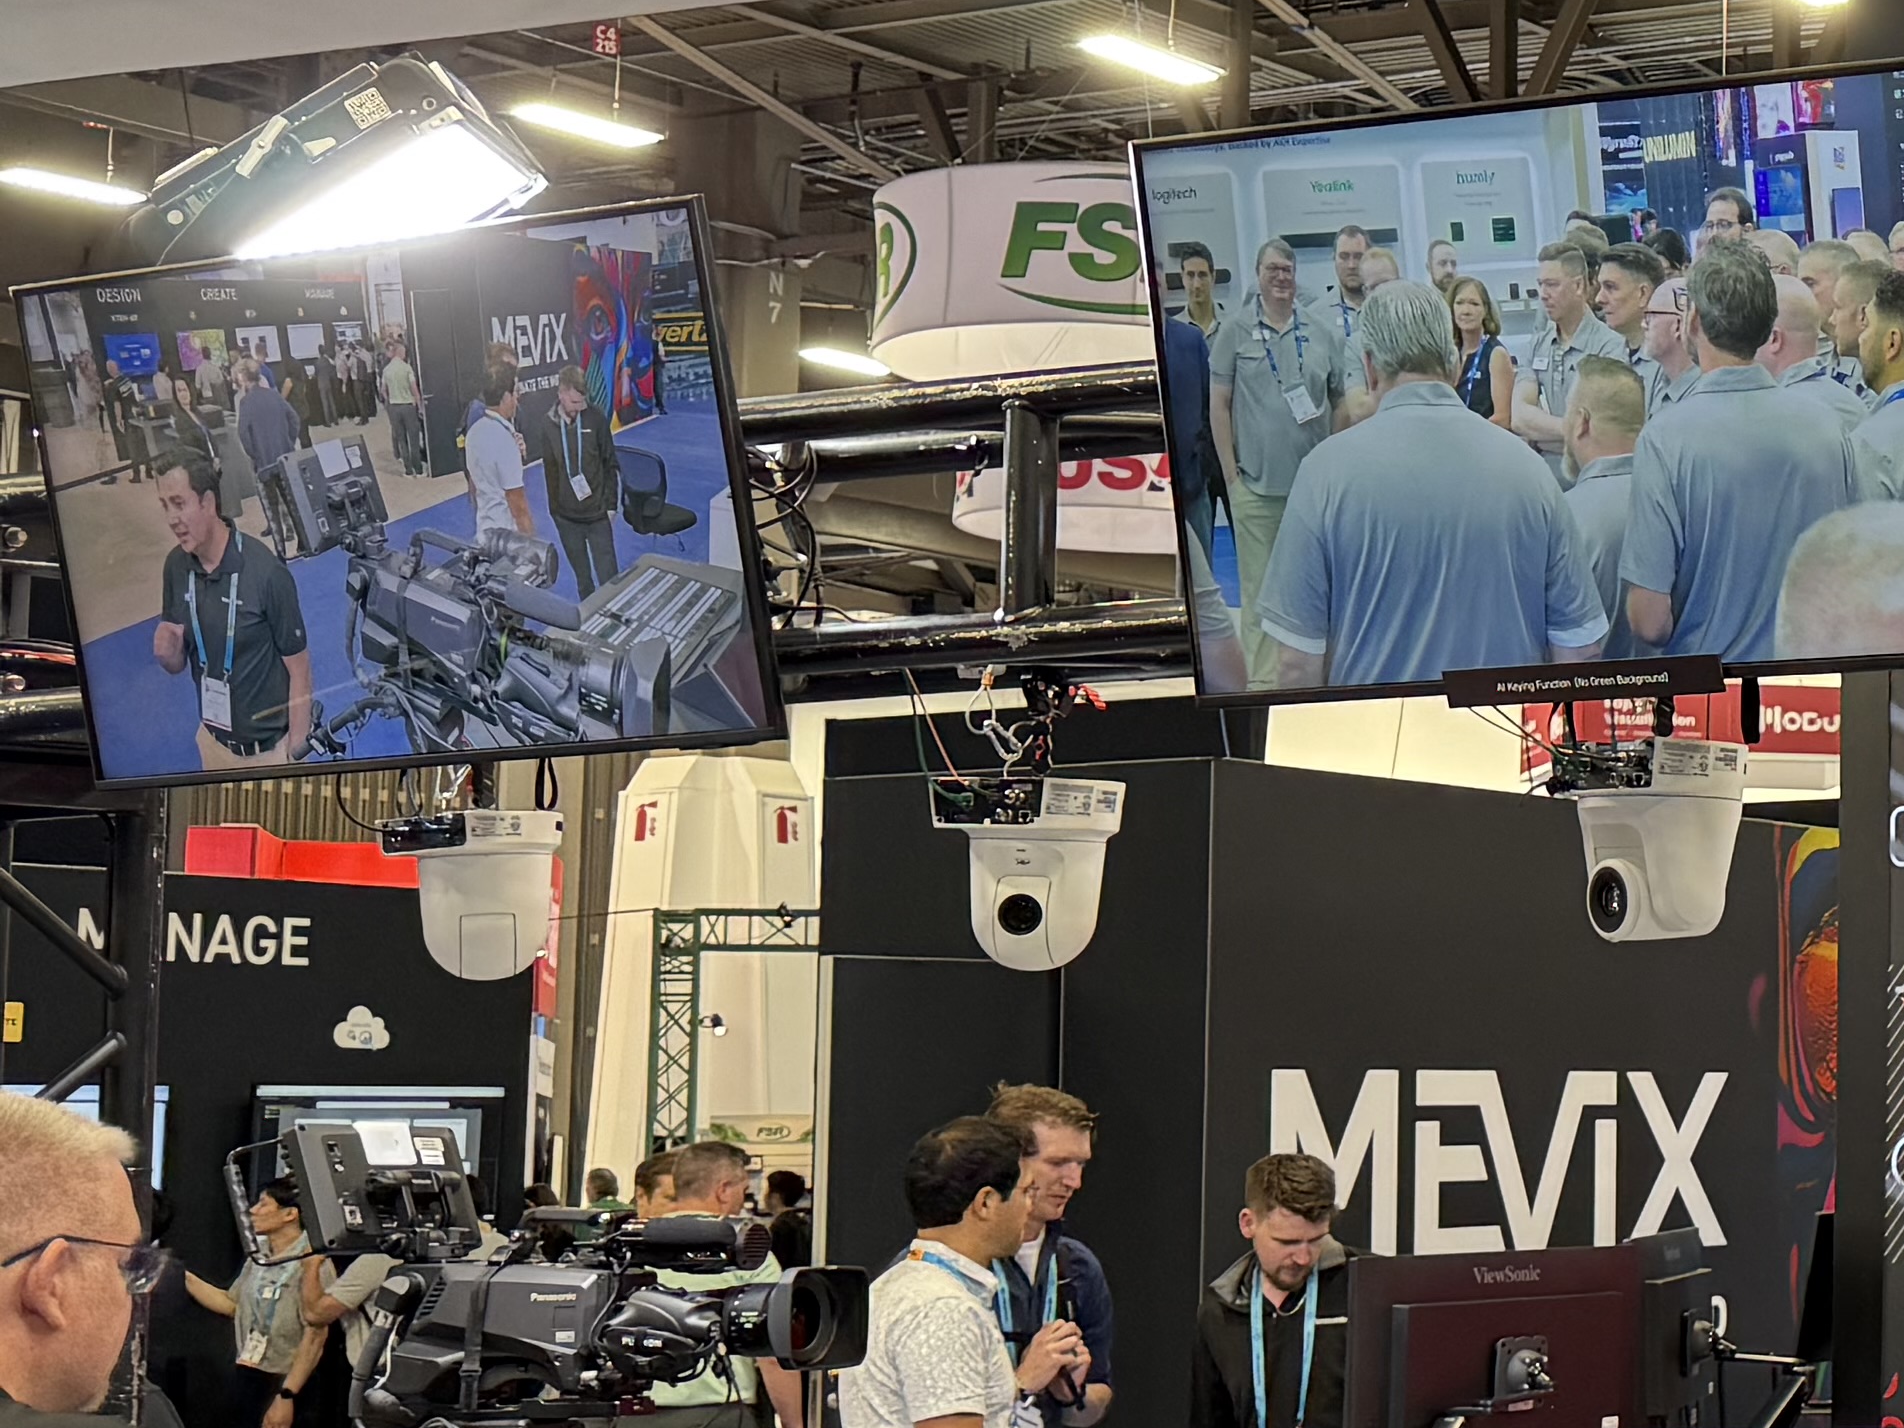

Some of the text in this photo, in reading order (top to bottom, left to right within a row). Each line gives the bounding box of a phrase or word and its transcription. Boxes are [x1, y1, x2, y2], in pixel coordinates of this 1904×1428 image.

[1000, 201, 1148, 282] FS
[1536, 678, 1571, 691] Function
[77, 907, 312, 966] MNAGE
[1473, 1263, 1541, 1284] ViewSonic
